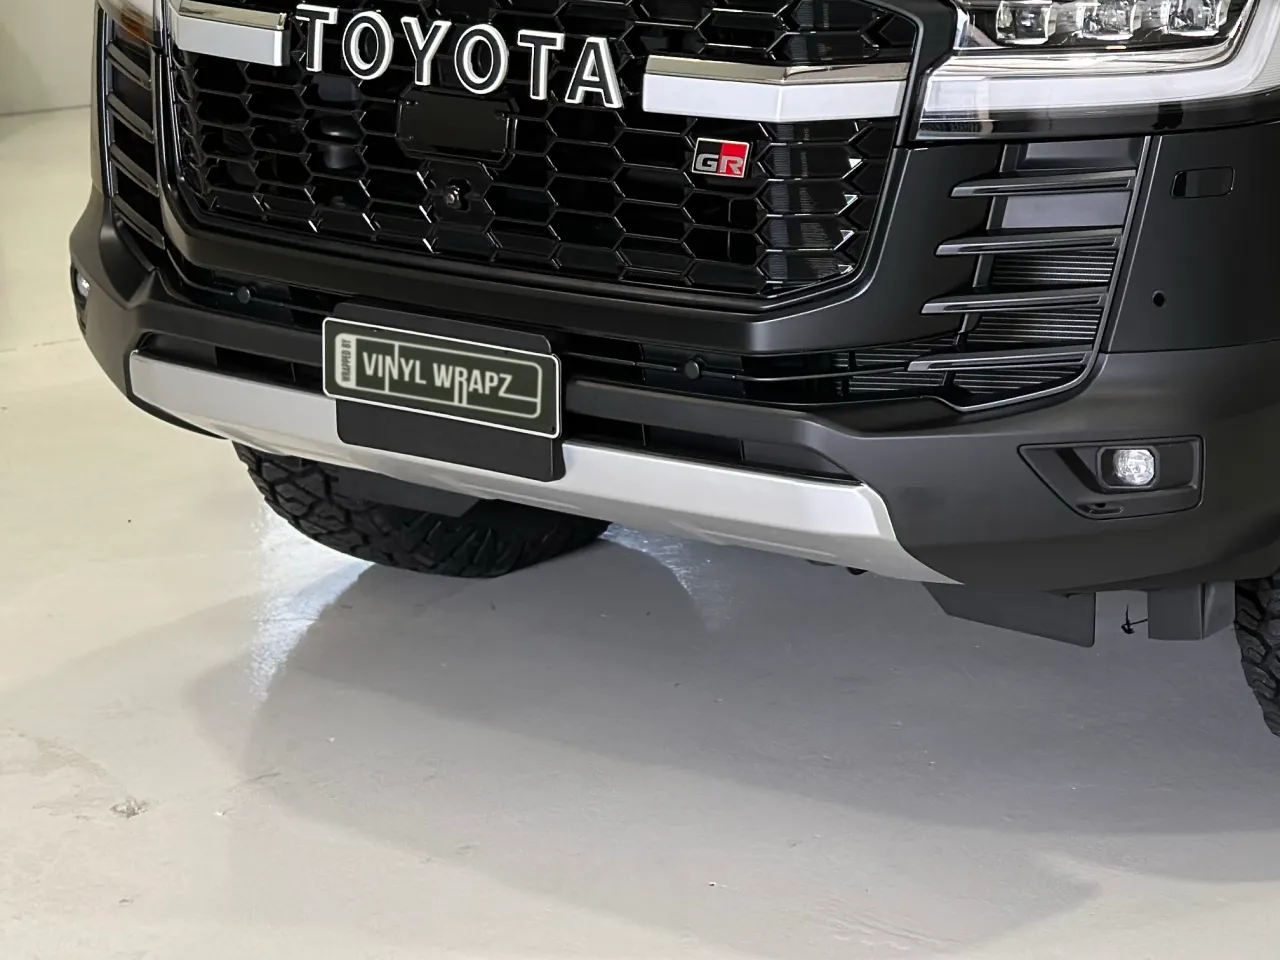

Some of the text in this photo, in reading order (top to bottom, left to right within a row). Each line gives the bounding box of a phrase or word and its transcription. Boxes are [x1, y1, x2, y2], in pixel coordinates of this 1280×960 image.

[295, 3, 624, 109] TOYOTA
[695, 153, 744, 175] GR
[340, 338, 352, 382] WRAPPED BY
[362, 351, 513, 397] VINYL WRAPZ
